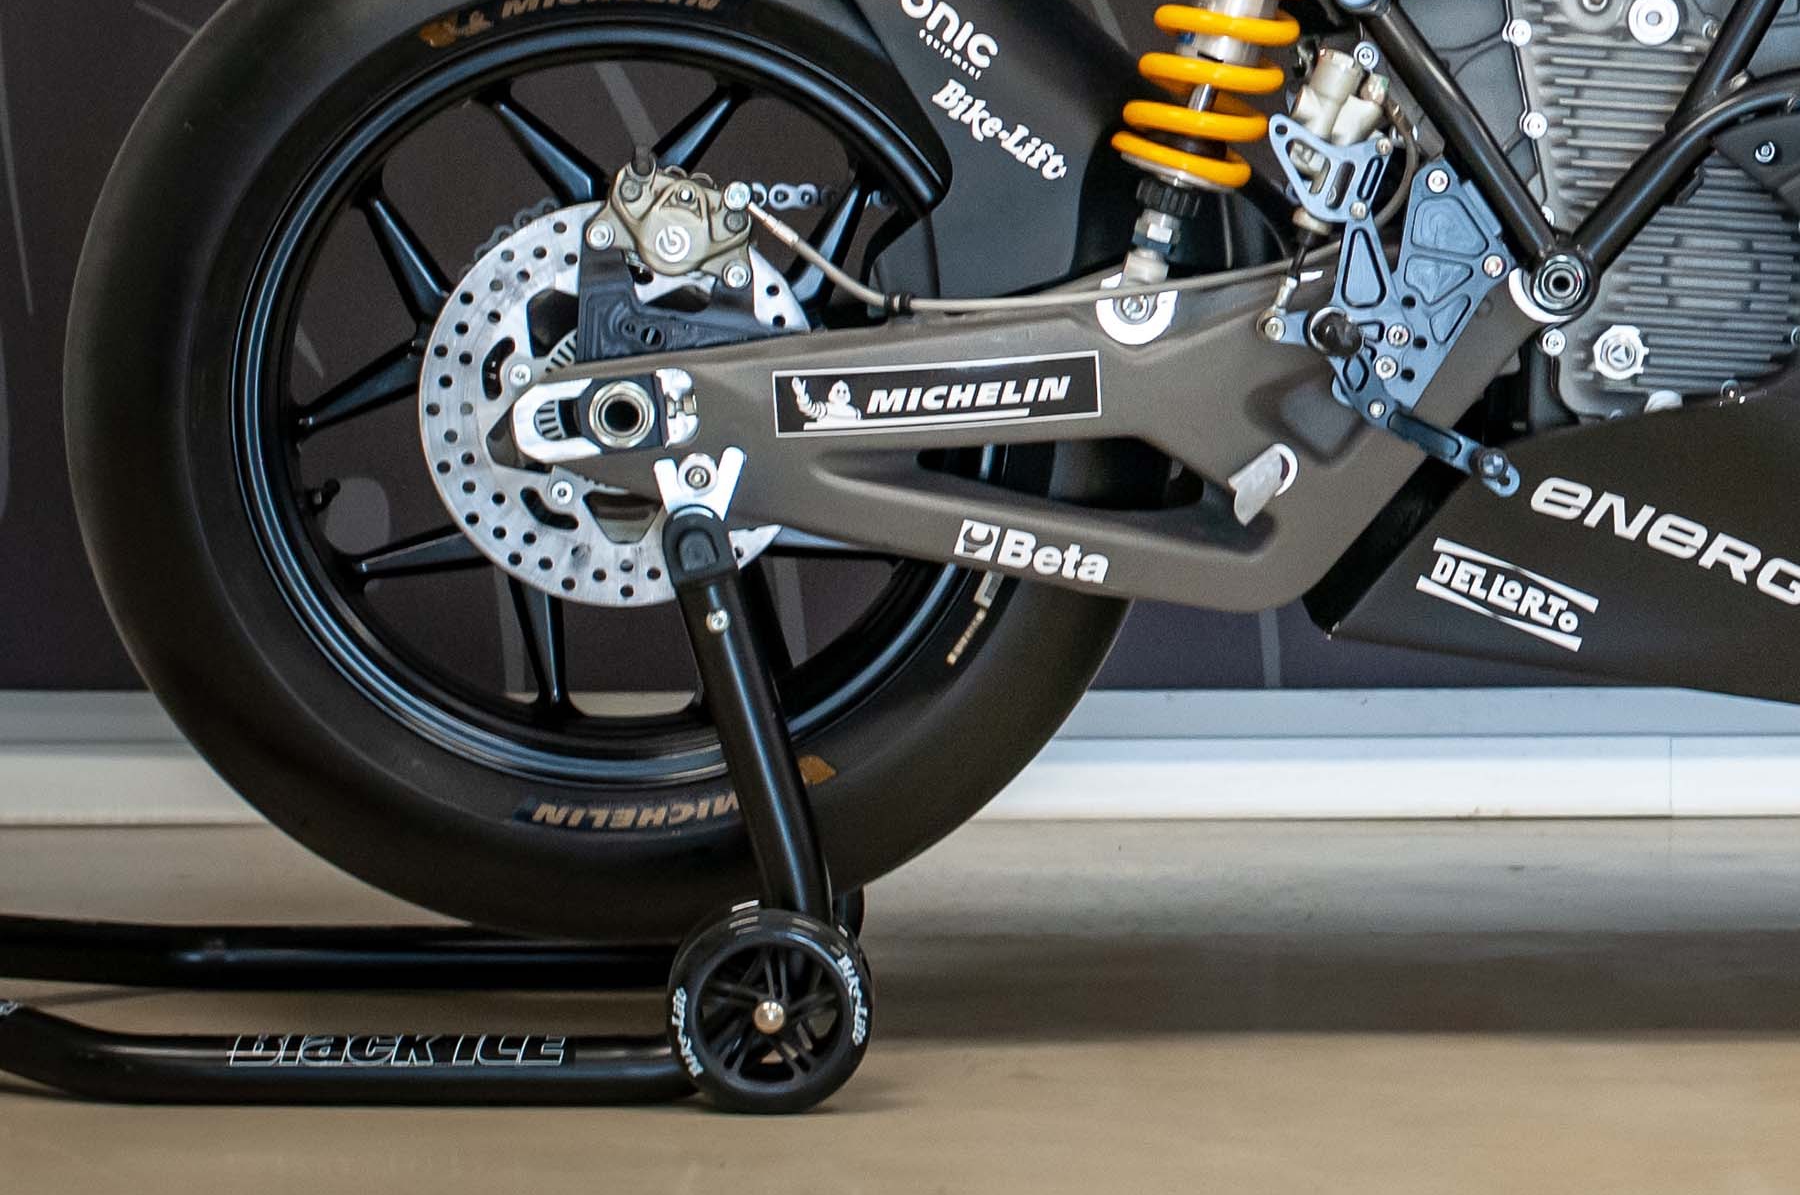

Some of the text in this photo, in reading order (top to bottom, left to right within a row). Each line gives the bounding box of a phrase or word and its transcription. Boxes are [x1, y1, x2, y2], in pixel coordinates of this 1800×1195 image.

[932, 78, 1068, 181] Bike-Lift
[866, 375, 1072, 415] MICHELIN
[997, 527, 1111, 585] Beta
